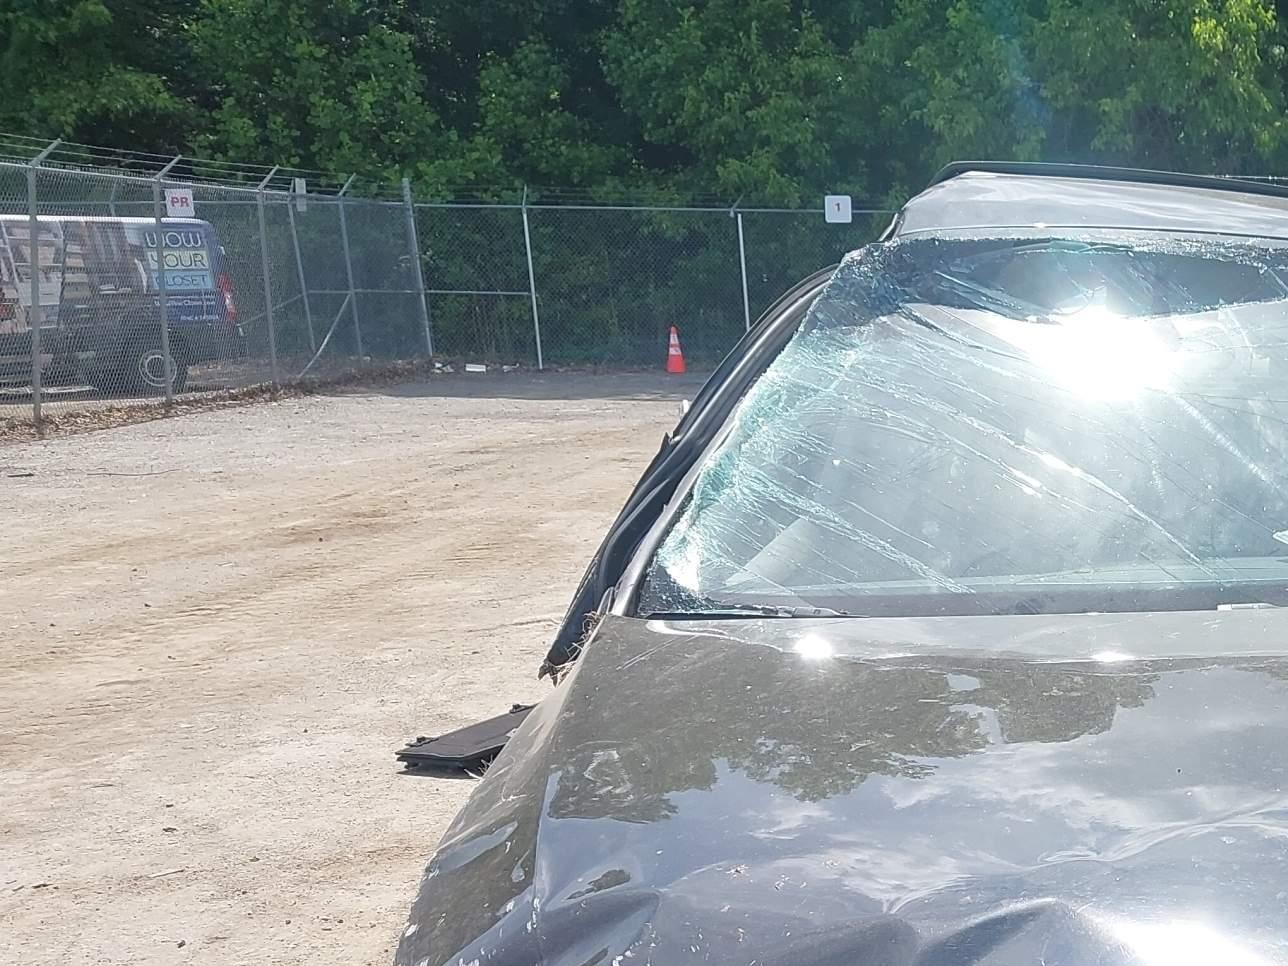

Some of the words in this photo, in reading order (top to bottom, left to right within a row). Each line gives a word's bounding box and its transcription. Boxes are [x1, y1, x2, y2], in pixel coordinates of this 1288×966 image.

[170, 196, 190, 208] PR
[834, 202, 841, 212] 1
[145, 231, 202, 248] WOW
